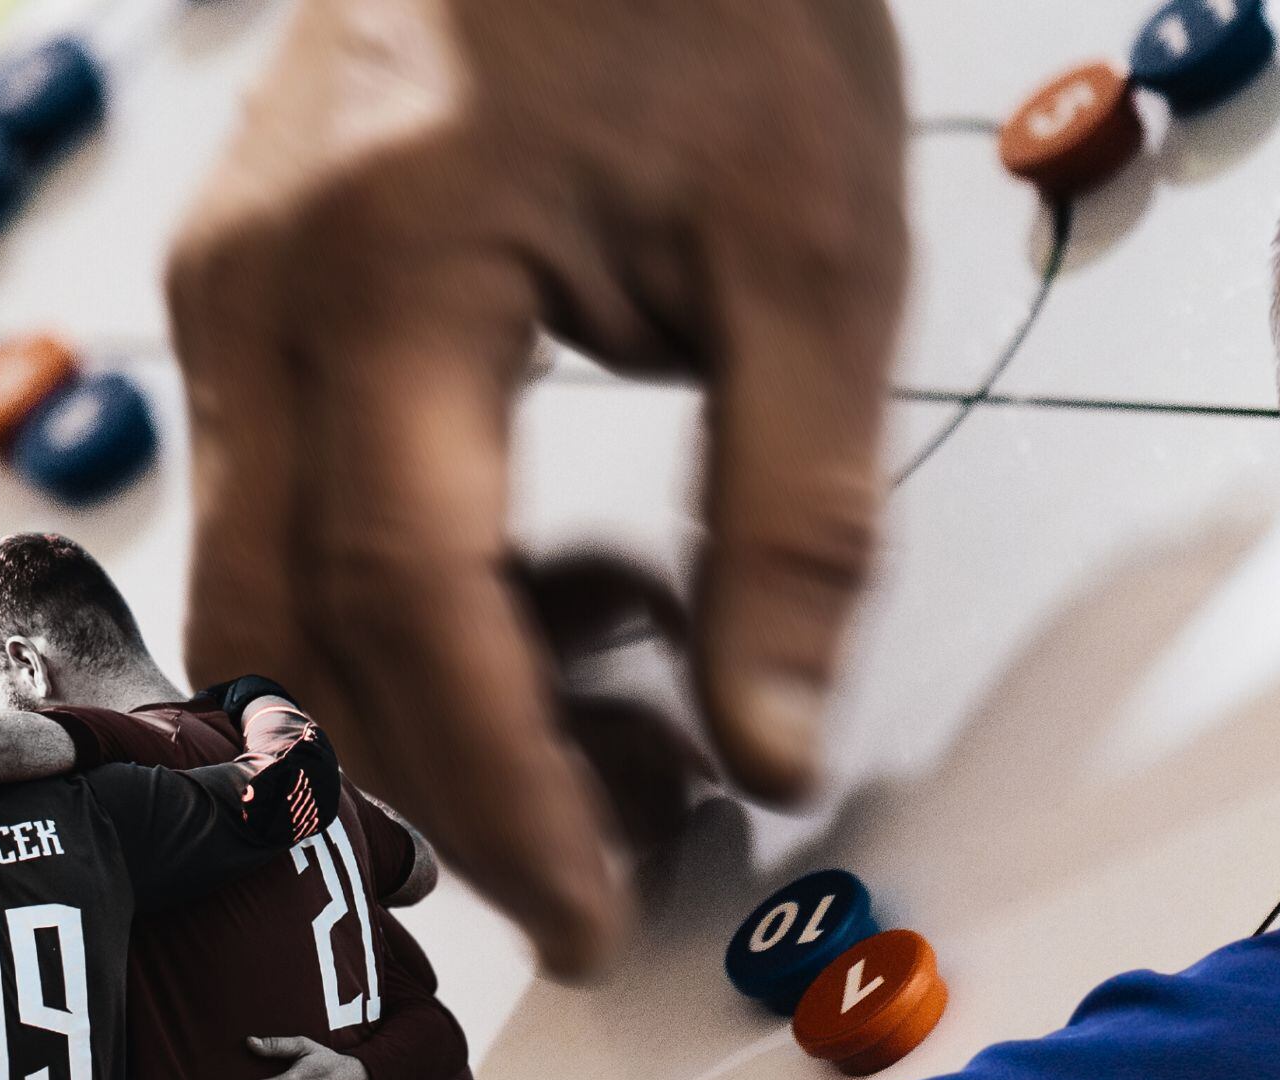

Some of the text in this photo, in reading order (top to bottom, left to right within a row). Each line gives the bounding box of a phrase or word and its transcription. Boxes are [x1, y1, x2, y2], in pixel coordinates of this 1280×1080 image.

[289, 816, 381, 1031] 21
[749, 894, 836, 953] 10
[840, 958, 885, 1014] 7
